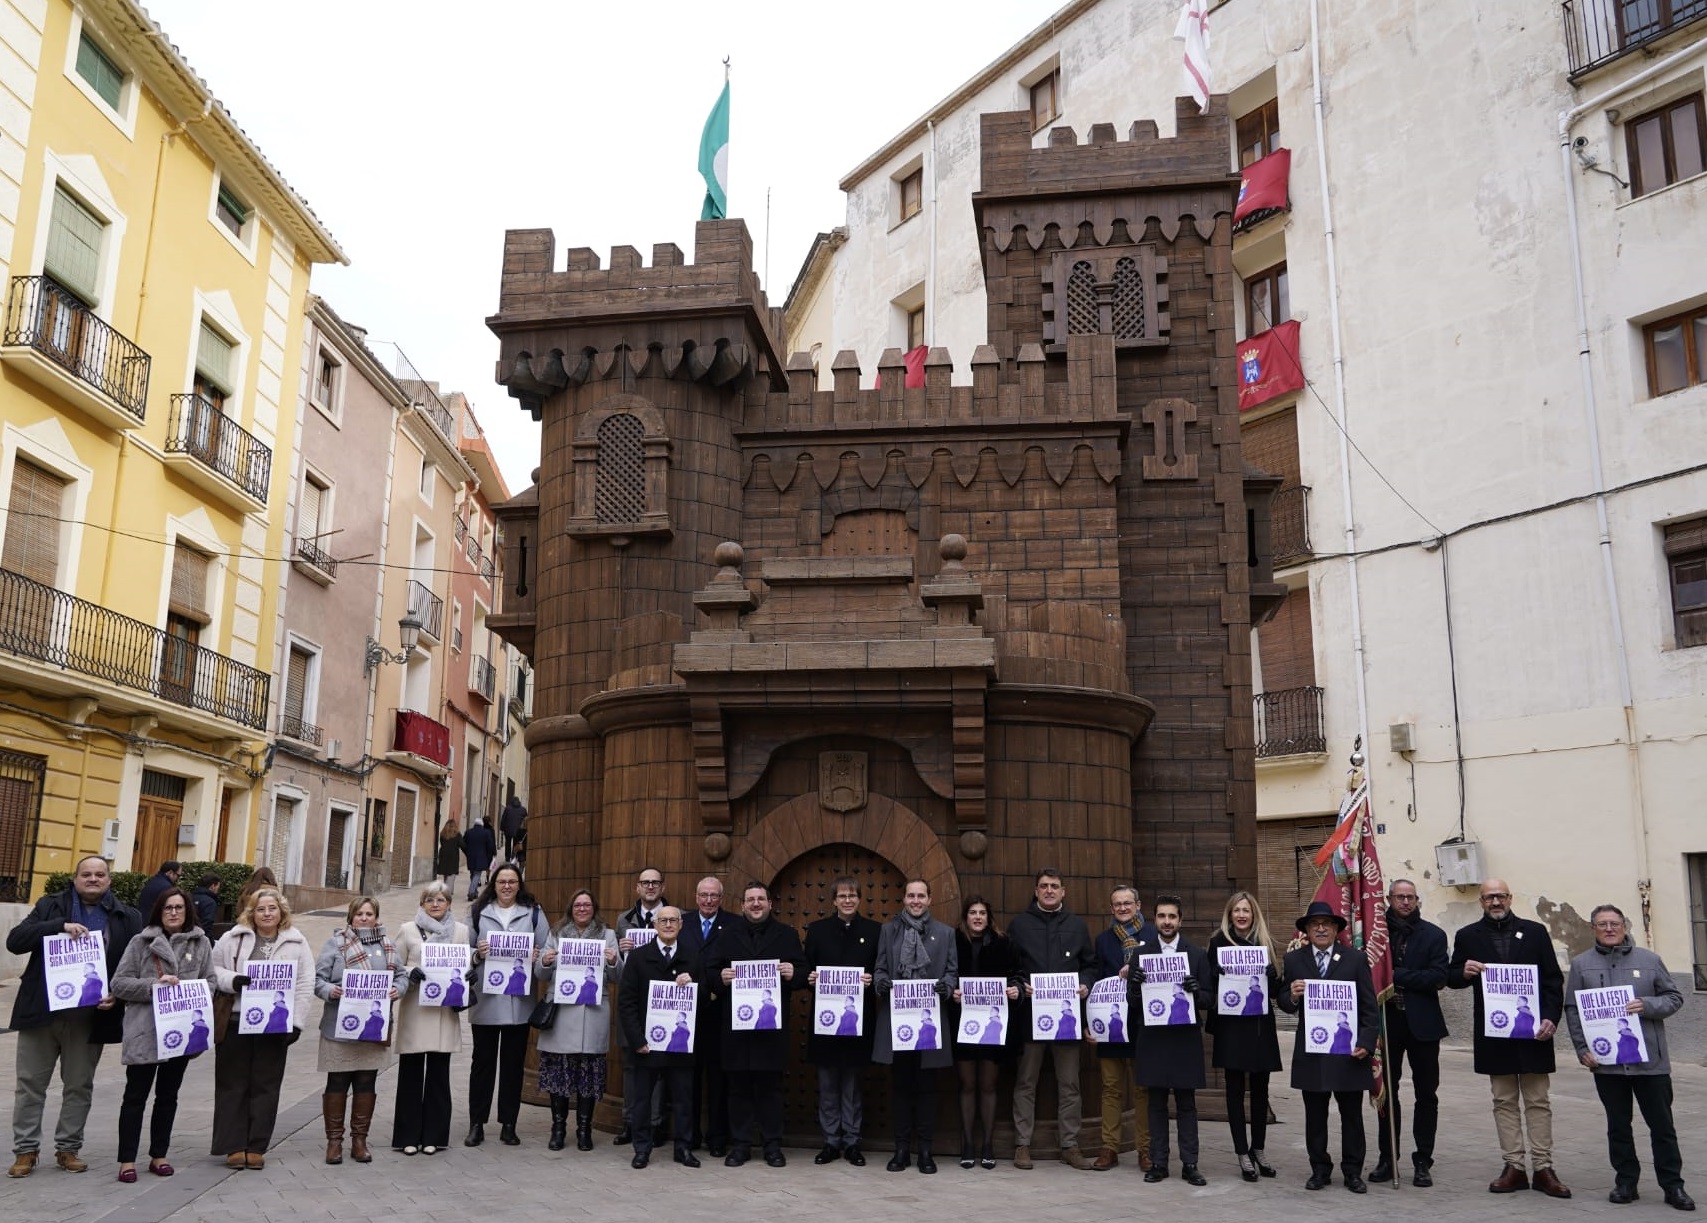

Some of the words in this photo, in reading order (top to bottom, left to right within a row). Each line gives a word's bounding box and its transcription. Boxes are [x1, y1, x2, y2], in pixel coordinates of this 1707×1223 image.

[49, 940, 62, 955] QUE
[64, 938, 74, 953] LA
[490, 934, 501, 948] QUE
[502, 935, 510, 948] LA
[511, 935, 530, 949] FESTA
[426, 946, 437, 957] QUE
[438, 946, 446, 958] LA
[448, 946, 466, 958] FESTA
[562, 942, 573, 955] QUE
[574, 942, 583, 955] LA
[584, 942, 601, 956] FESTA
[1143, 959, 1155, 972] QUE
[1156, 958, 1164, 971] LA
[1166, 956, 1186, 971] FESTA
[1222, 951, 1233, 964] QUE
[1234, 951, 1243, 964] LA
[1245, 950, 1264, 963] FESTA
[248, 964, 261, 978] QUE
[262, 964, 270, 978] LA
[272, 964, 292, 978] FESTA
[735, 965, 747, 978] QUE
[748, 964, 756, 978] LA
[758, 964, 776, 977] FESTA
[820, 970, 831, 983] QUE
[833, 970, 840, 983] LA
[842, 970, 860, 984] FESTA
[1172, 972, 1185, 982] FEST
[1486, 968, 1499, 982] QUE
[1500, 968, 1509, 982] LA
[1512, 968, 1533, 983] FESTA
[346, 974, 358, 988] QUE
[359, 974, 368, 988] LA
[369, 974, 388, 988] FESTA
[1035, 976, 1046, 988] QUE
[1047, 976, 1055, 988] LA
[1057, 976, 1075, 988] FESTA
[158, 986, 172, 1002] QUE
[174, 985, 183, 1000] LA
[184, 982, 206, 998] FESTA
[653, 985, 665, 998] QUE
[666, 986, 674, 999] LA
[675, 986, 693, 1000] FESTA
[894, 984, 905, 998] QUE
[906, 984, 915, 998] LA
[964, 982, 973, 994] QUE
[975, 982, 983, 994] LA
[985, 982, 1003, 995] FESTA
[1309, 984, 1321, 998] QUE
[1322, 984, 1330, 999] LA
[1332, 984, 1352, 1000] FESTA
[1581, 994, 1594, 1009] QUE
[1596, 992, 1606, 1007] LA
[1607, 990, 1629, 1006] FESTA
